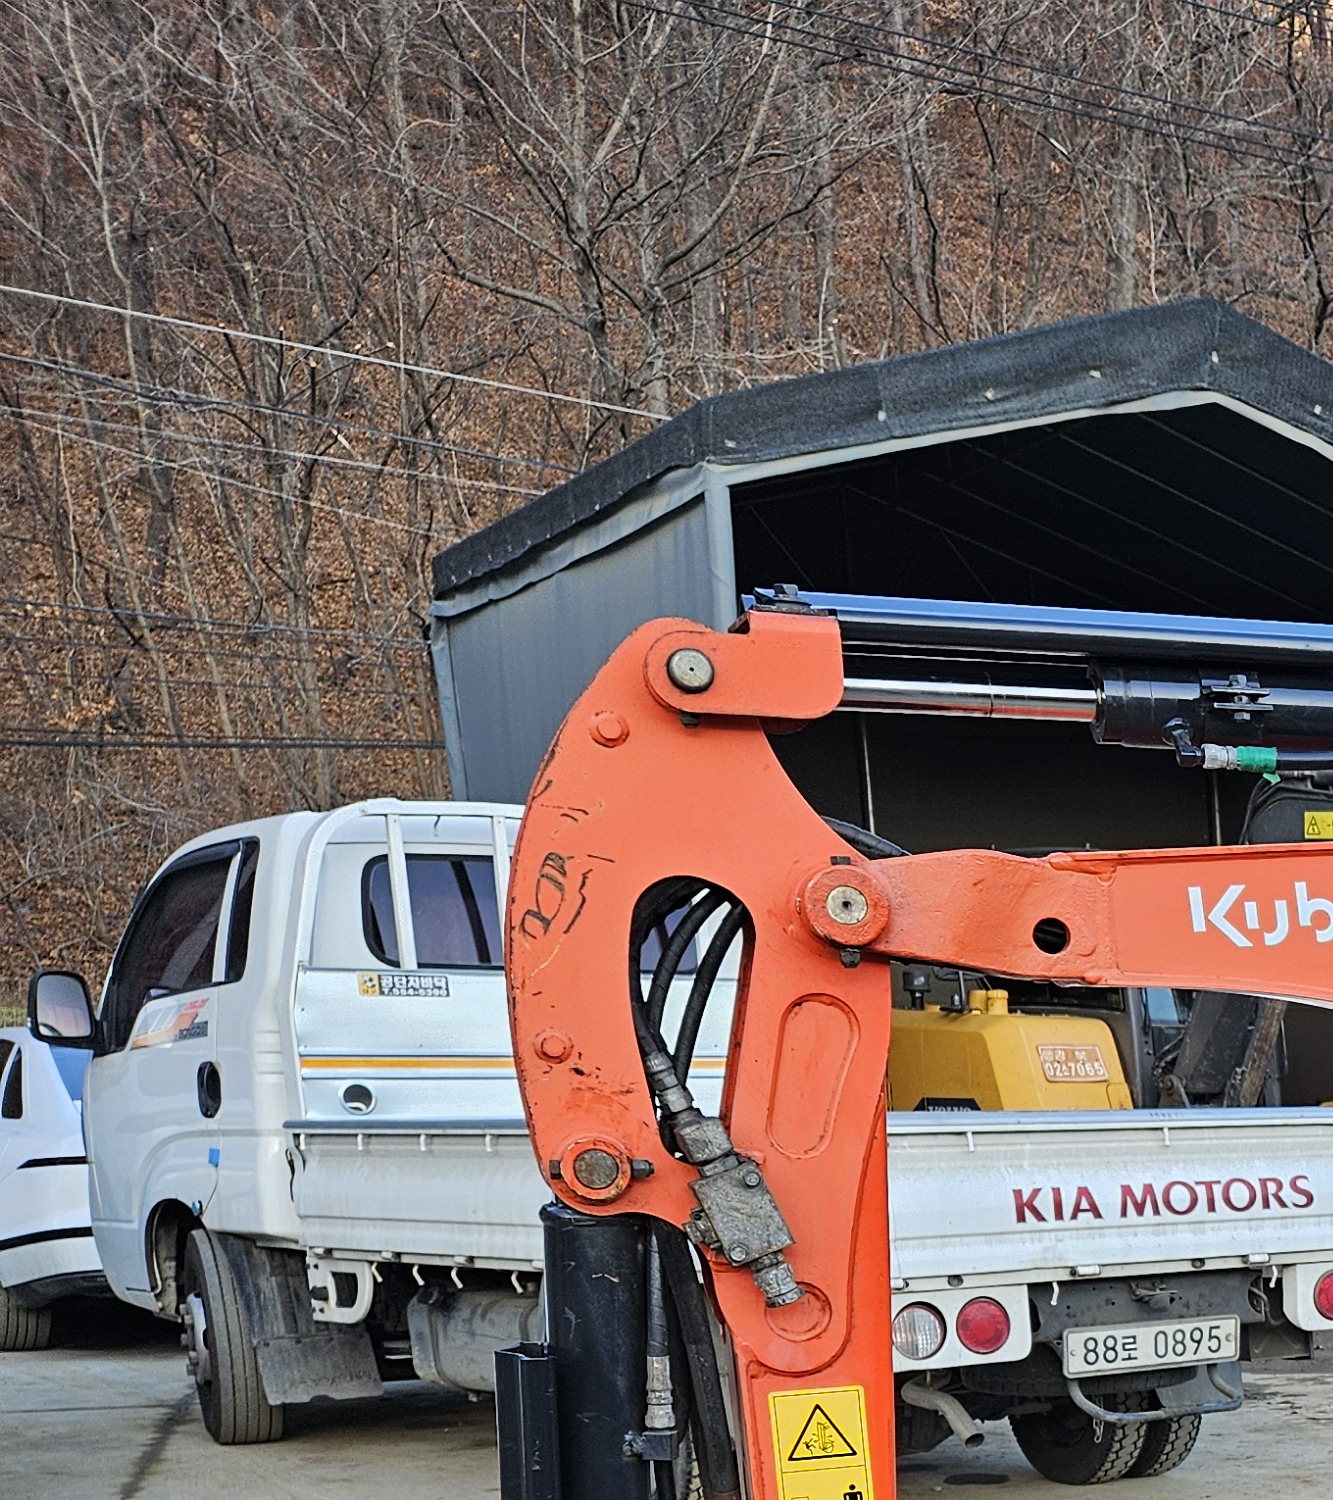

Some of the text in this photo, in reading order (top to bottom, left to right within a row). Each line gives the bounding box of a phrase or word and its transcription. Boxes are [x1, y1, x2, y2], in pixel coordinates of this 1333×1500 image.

[1012, 1175, 1315, 1224] KIA MOTORS
[1082, 1325, 1223, 1366] 88로 0895
